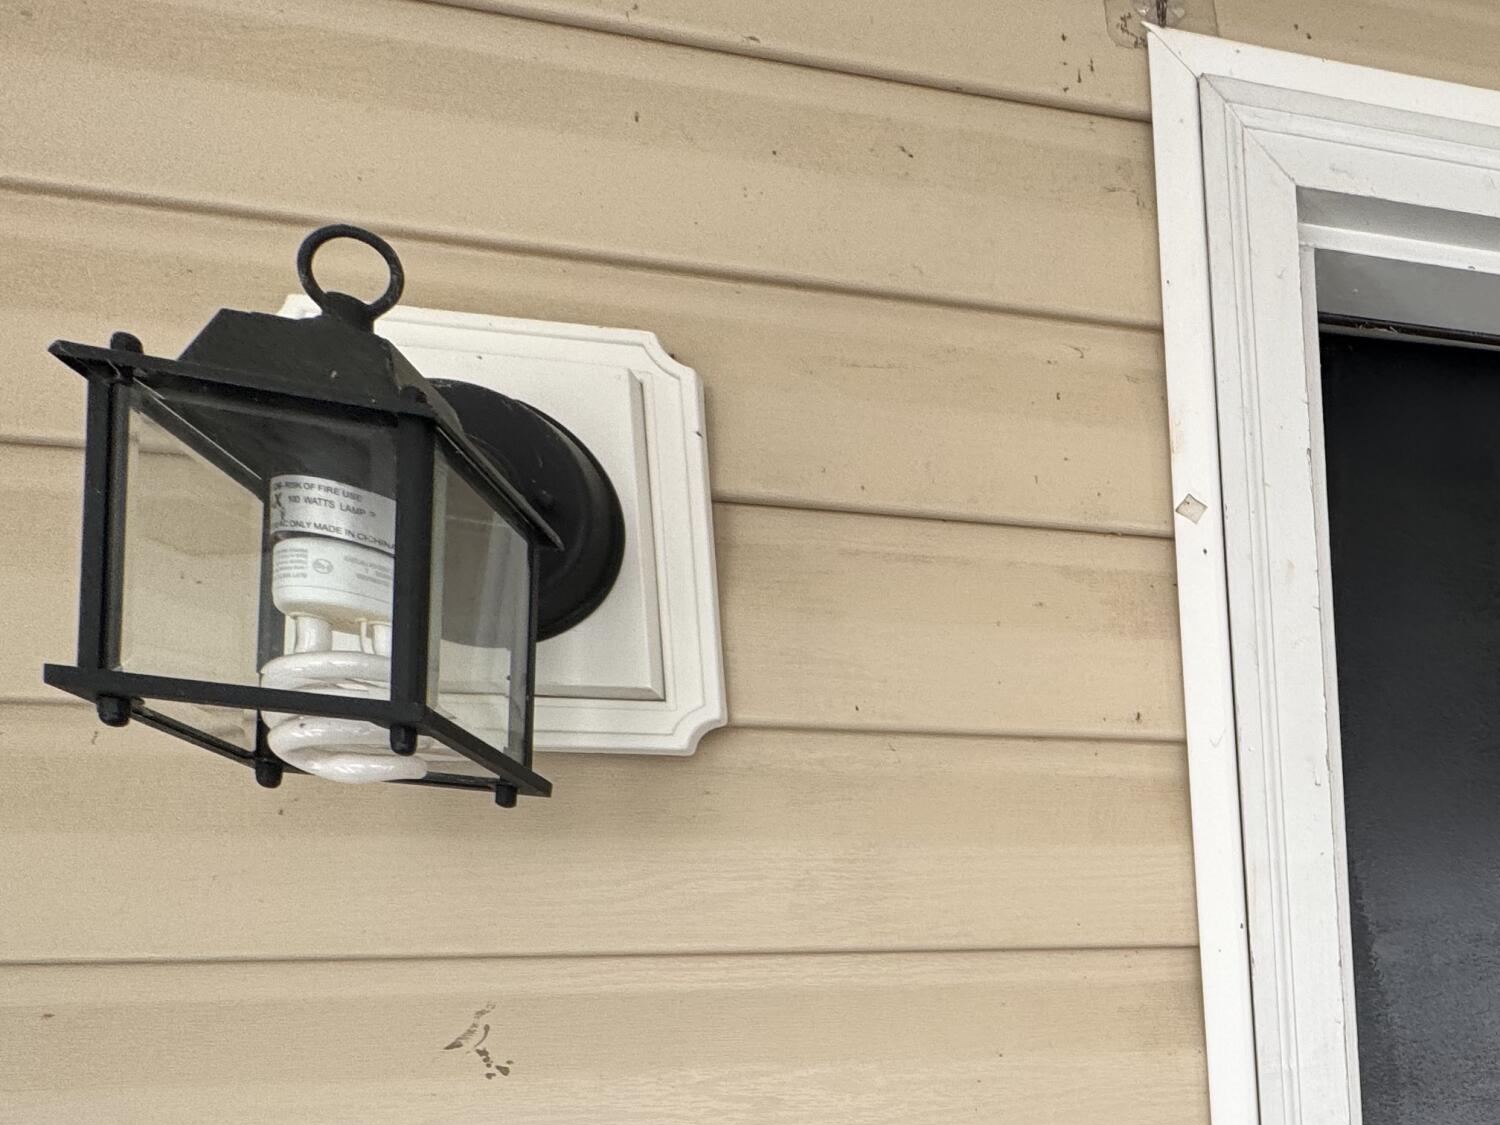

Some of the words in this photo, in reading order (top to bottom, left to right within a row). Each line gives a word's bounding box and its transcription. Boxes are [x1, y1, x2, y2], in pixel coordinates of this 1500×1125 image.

[303, 482, 315, 490] OF
[318, 485, 340, 496] FIRE
[342, 489, 361, 502] USE
[303, 496, 336, 509] WATTS
[339, 502, 366, 515] LAMP
[290, 520, 312, 529] ONLY
[313, 522, 343, 535] MADE
[344, 528, 356, 539] IN
